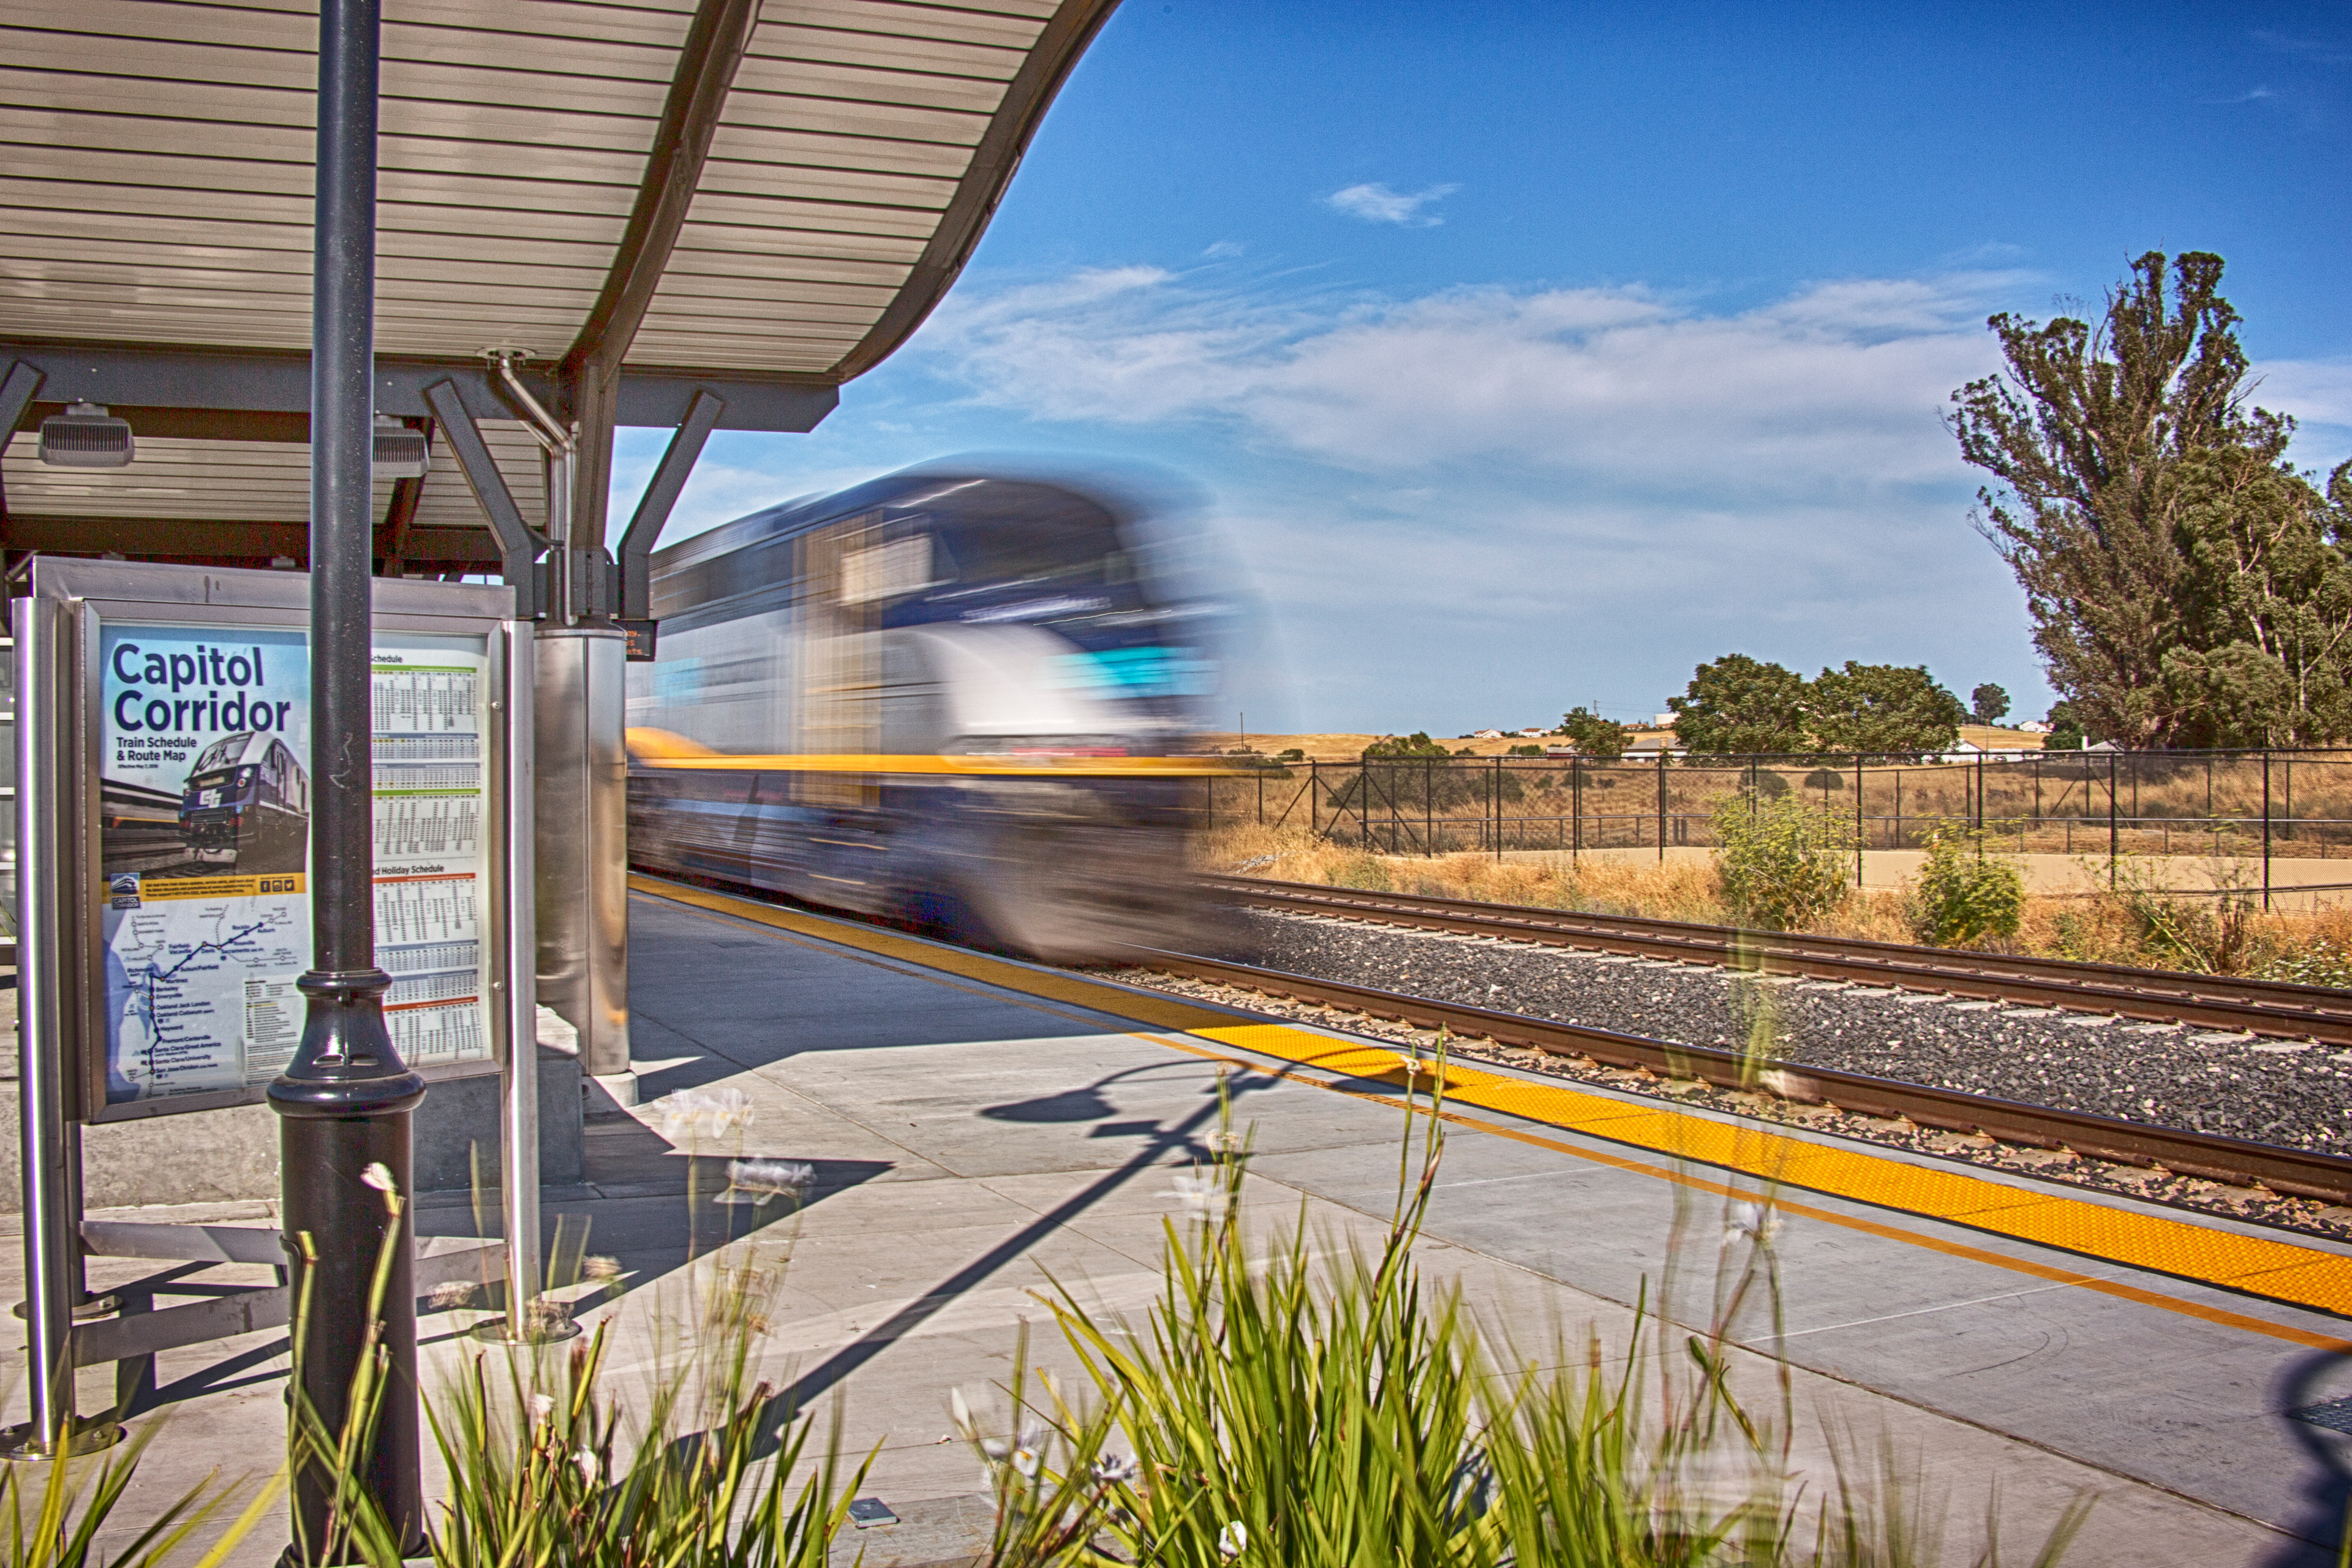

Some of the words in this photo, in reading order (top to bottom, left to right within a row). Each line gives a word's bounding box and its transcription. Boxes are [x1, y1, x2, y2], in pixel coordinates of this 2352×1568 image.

[113, 643, 263, 693] Capitol
[114, 690, 290, 731] Corridor
[116, 737, 145, 747] Train
[147, 737, 197, 747] Schedule
[116, 750, 124, 761] &
[127, 750, 160, 761] Route
[163, 750, 186, 763] Map
[382, 866, 409, 875] Holiday
[411, 865, 445, 873] Schedule
